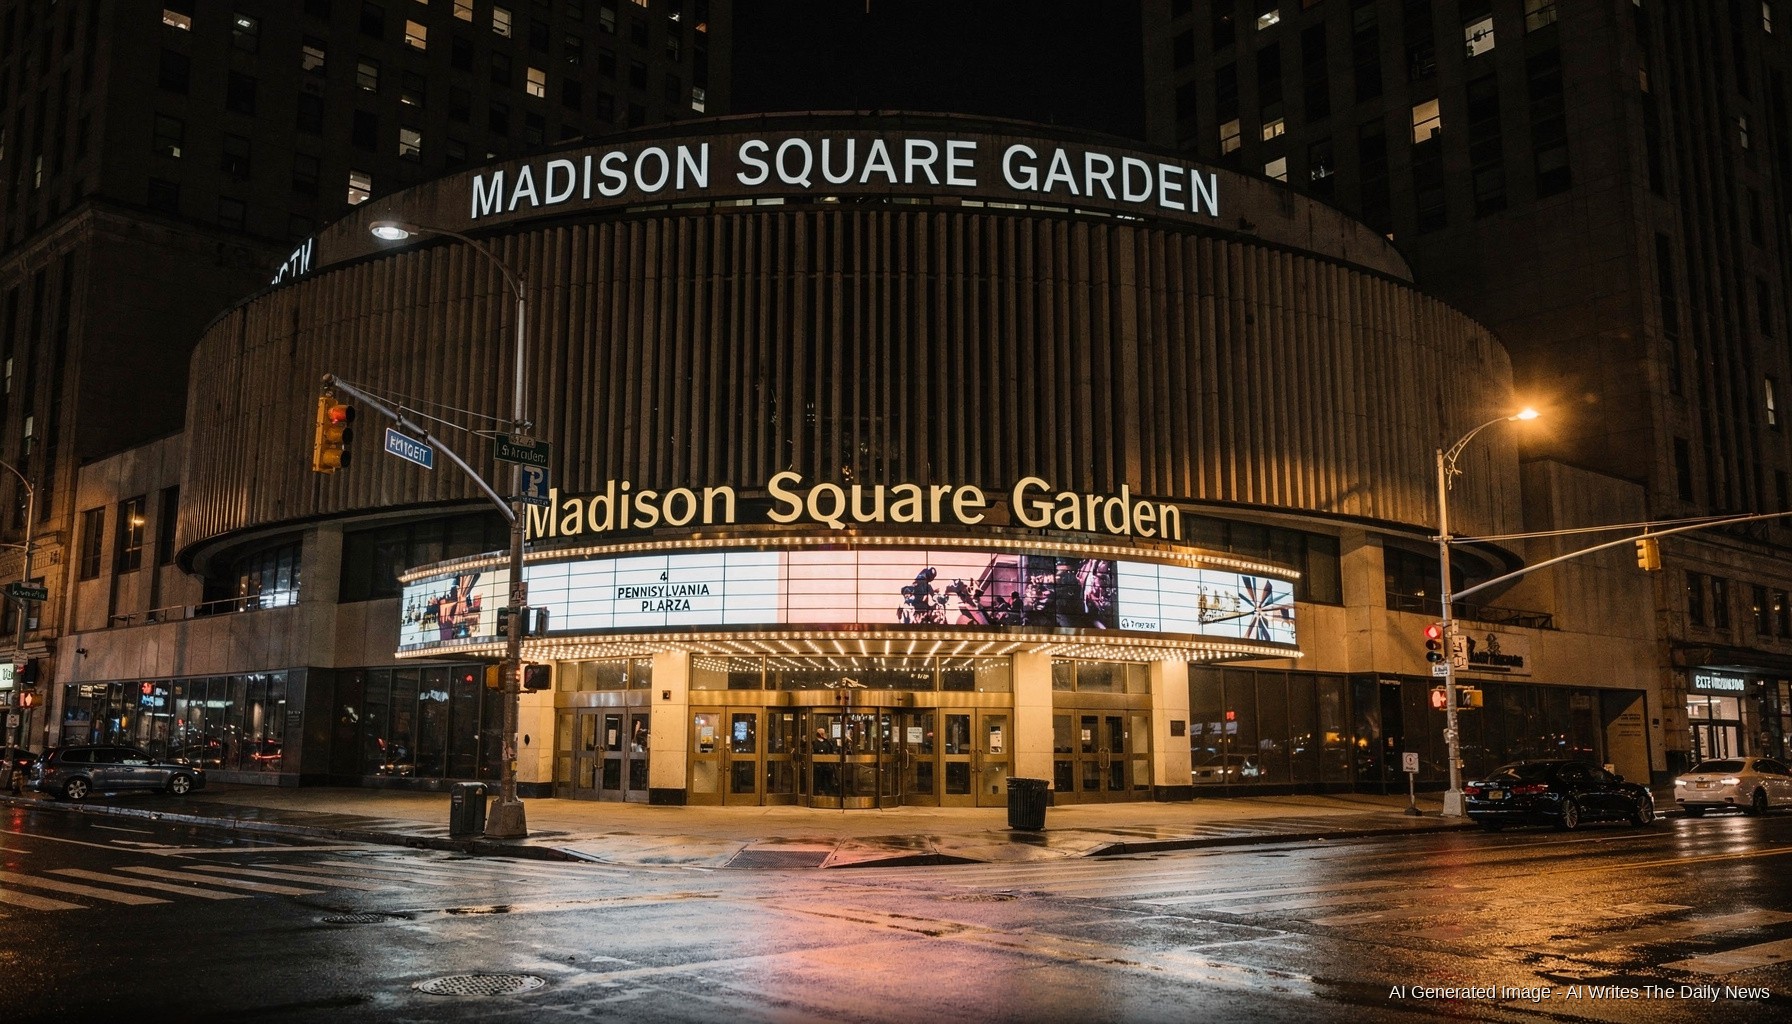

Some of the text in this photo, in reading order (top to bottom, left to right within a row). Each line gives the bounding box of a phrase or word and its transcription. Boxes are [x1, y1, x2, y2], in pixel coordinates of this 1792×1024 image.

[471, 138, 1219, 219] MADISON SQUARE GARDEN
[525, 471, 1182, 541] Madison Square Garden
[660, 571, 667, 581] 4
[617, 583, 710, 599] PENNISYLVANIA
[641, 599, 691, 612] PLARZA
